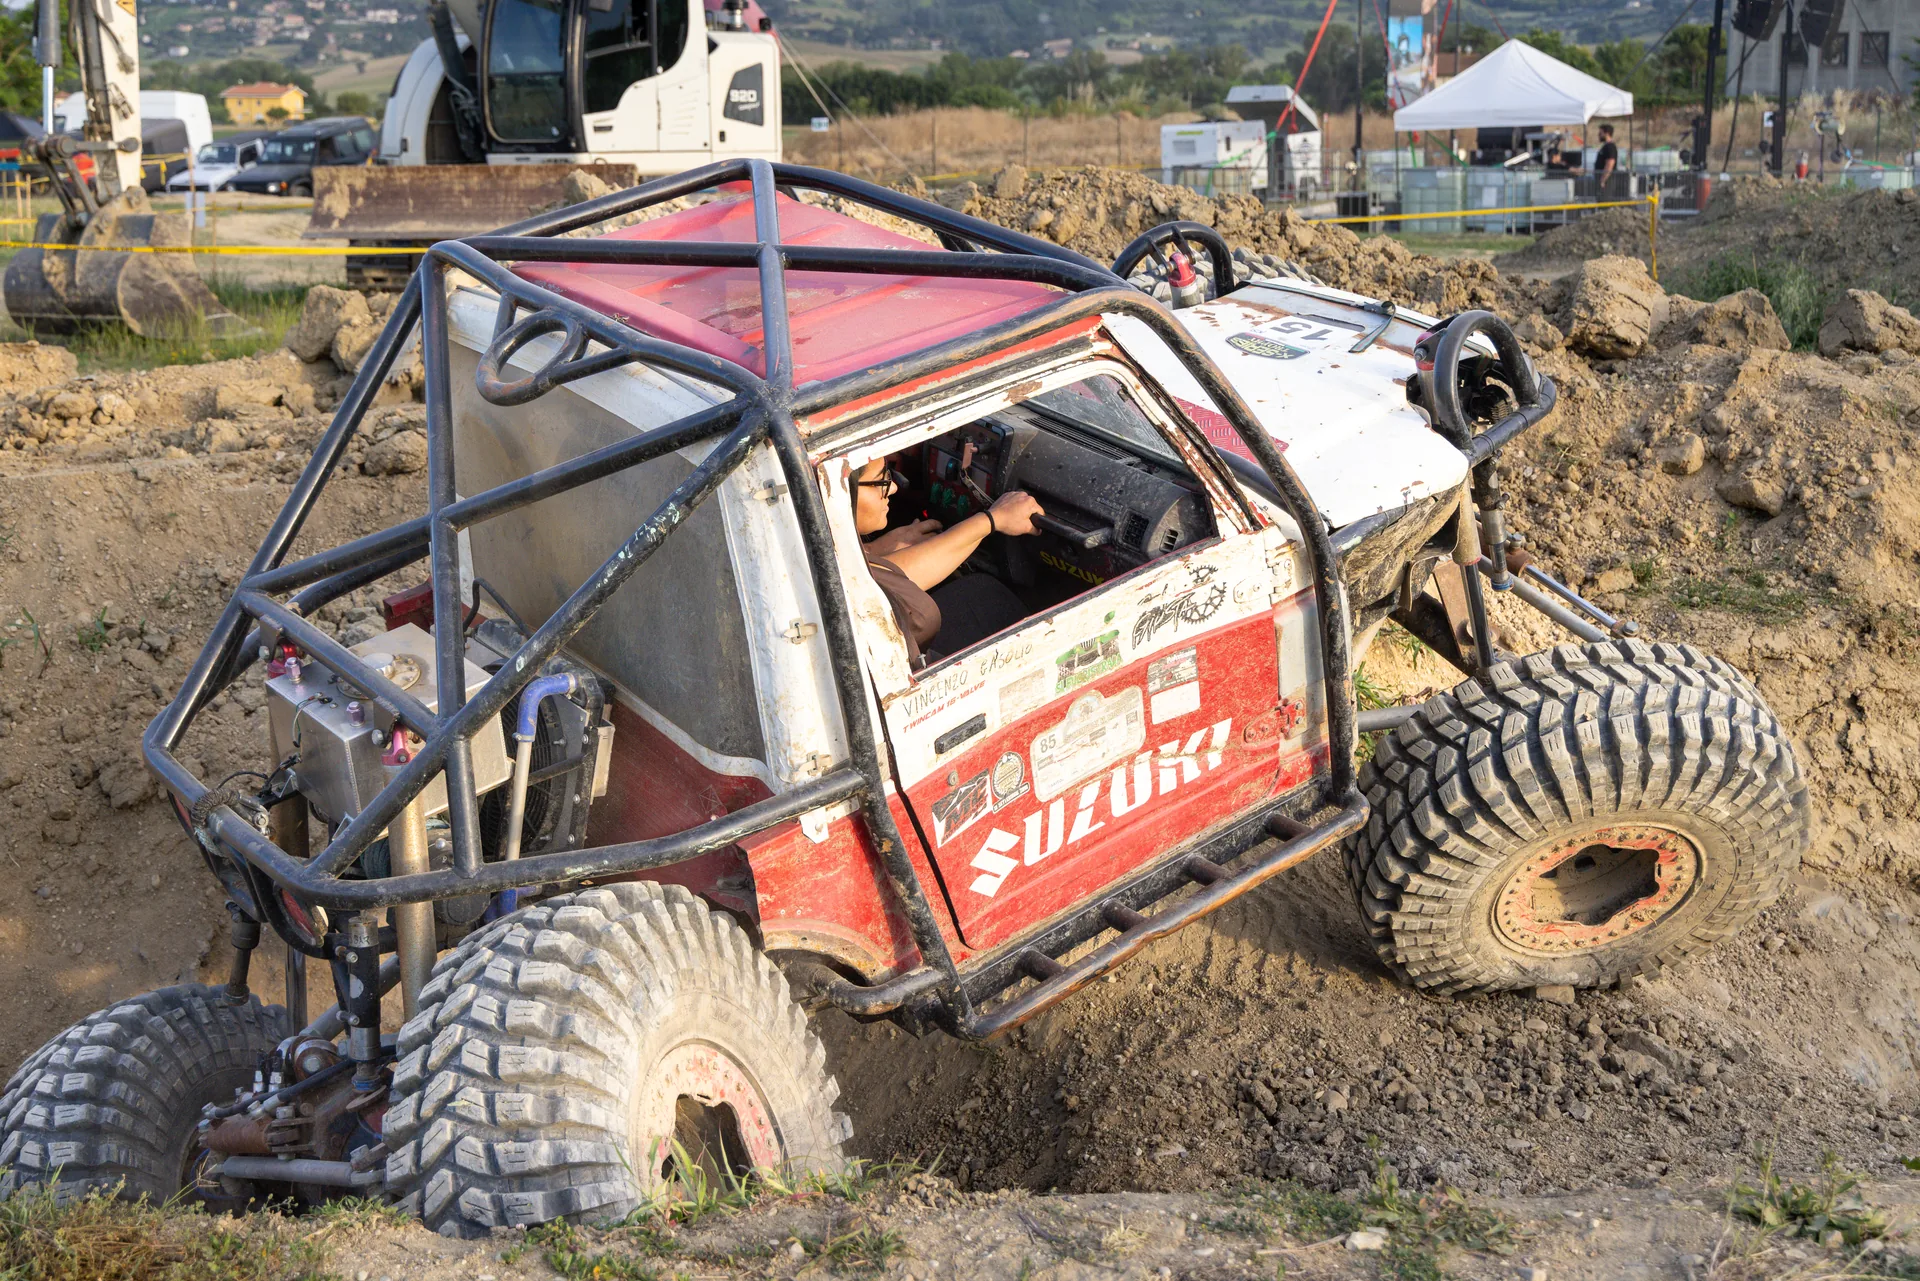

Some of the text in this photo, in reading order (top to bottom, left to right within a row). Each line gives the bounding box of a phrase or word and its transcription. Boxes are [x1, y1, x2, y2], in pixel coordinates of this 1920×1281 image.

[730, 89, 757, 102] 920
[1269, 321, 1333, 341] 15
[903, 703, 945, 734] TWINCAM
[1040, 734, 1057, 754] 85
[968, 717, 1232, 898] SUZUKI
